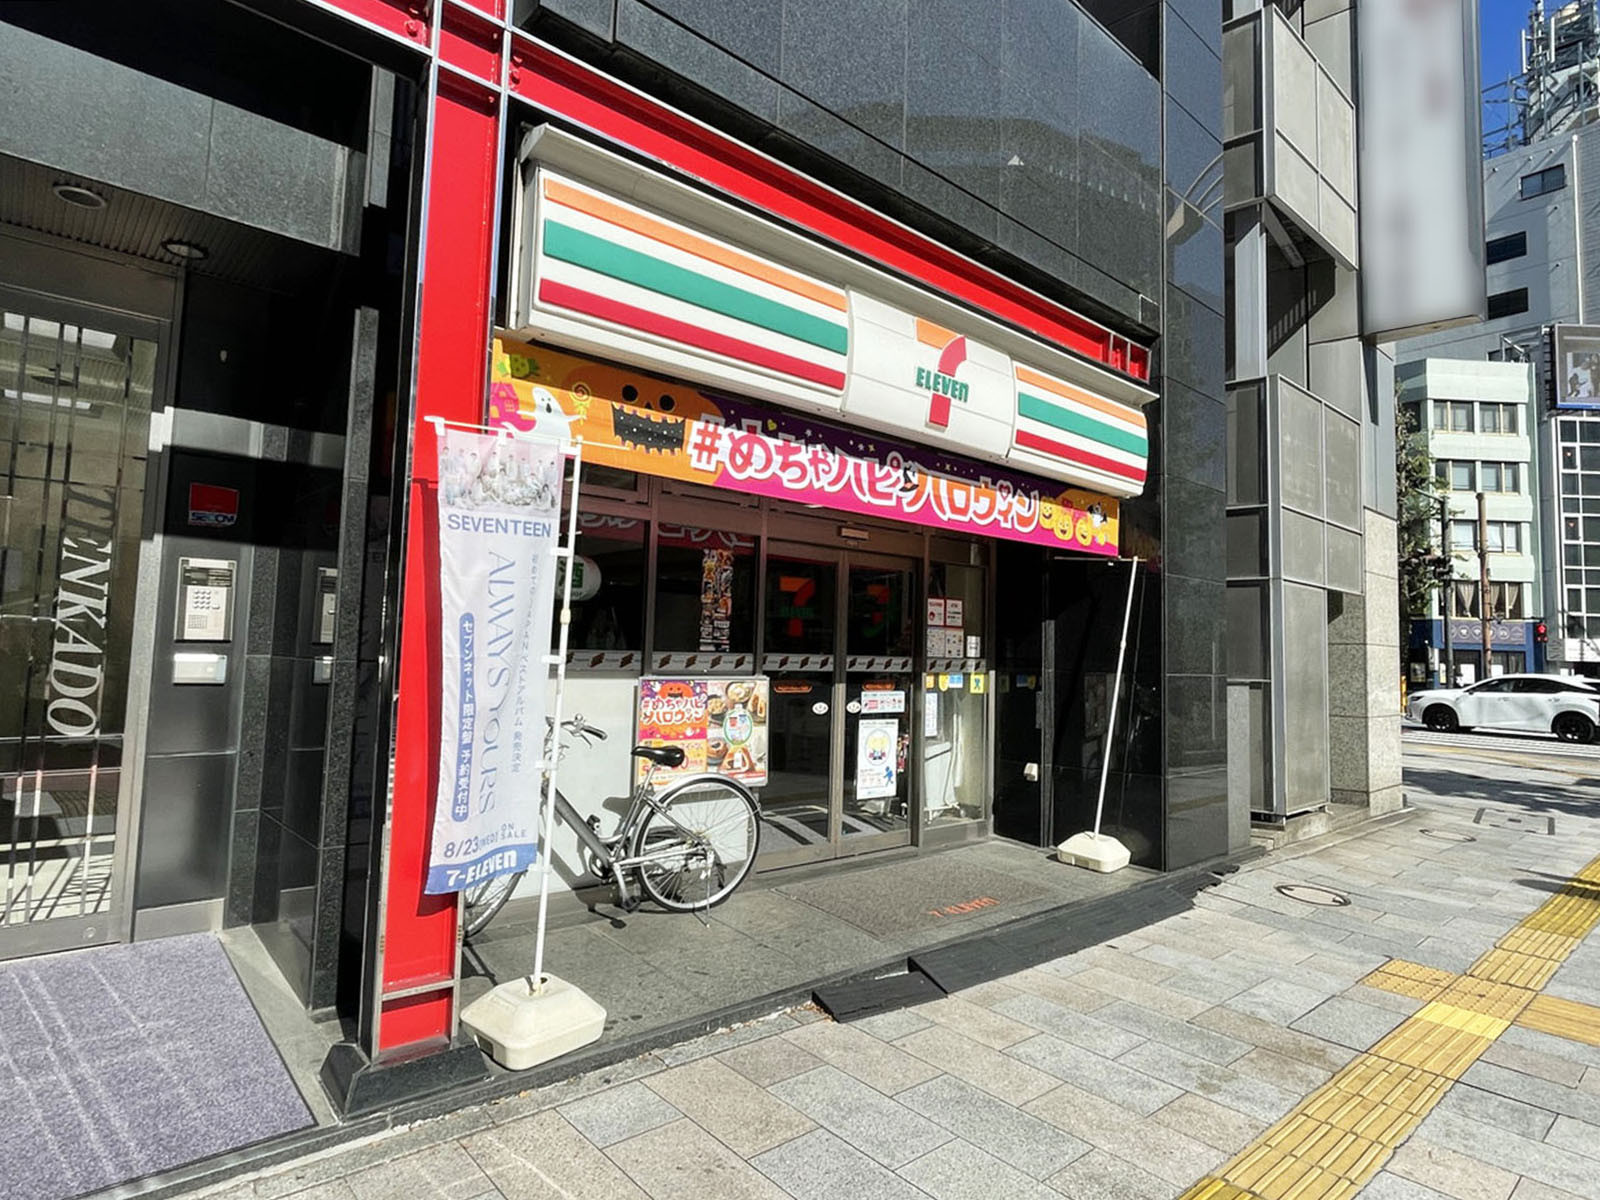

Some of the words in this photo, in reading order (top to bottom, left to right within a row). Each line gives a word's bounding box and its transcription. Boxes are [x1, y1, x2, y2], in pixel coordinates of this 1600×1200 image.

[447, 513, 551, 538] SEVENTEEN
[47, 484, 118, 737] TENKADO
[487, 550, 515, 688] ALWAYS
[479, 677, 511, 815] YOURS
[501, 823, 515, 831] ON
[501, 829, 528, 840] SALE
